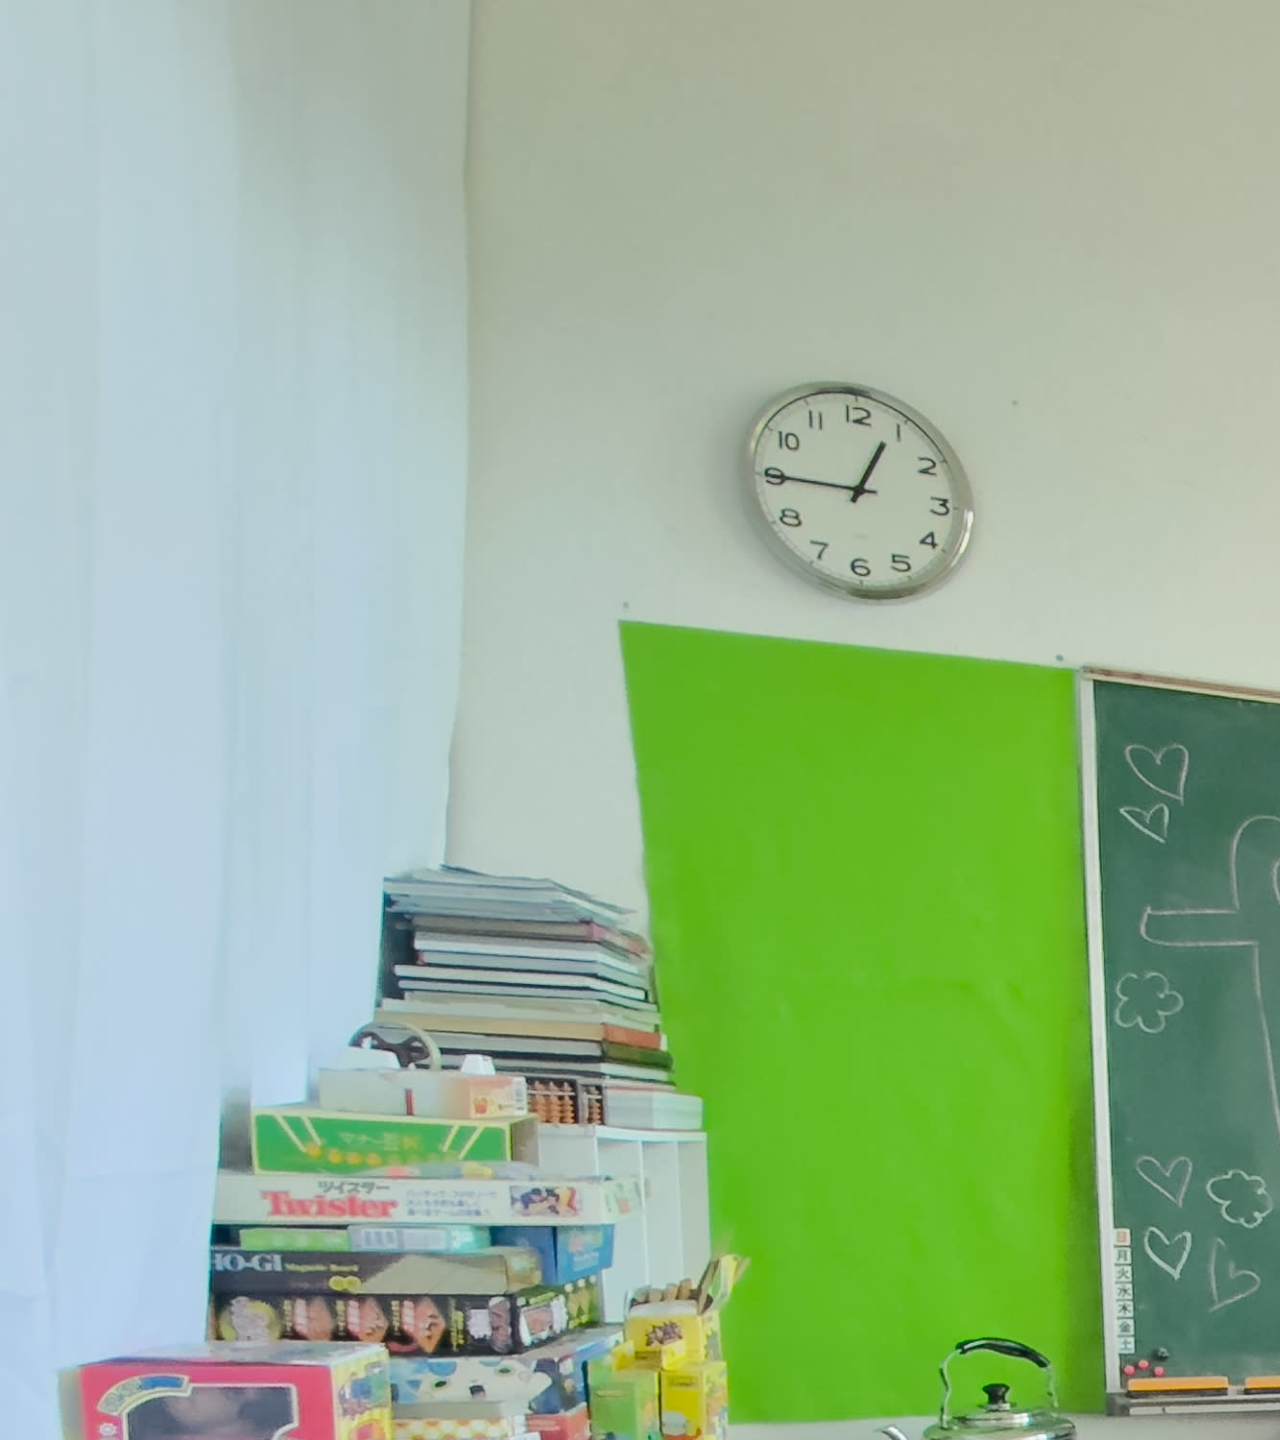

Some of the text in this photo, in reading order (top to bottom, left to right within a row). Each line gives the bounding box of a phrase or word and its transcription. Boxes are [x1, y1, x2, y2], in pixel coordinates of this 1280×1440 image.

[808, 410, 823, 430] 11
[845, 404, 872, 427] 12
[778, 430, 800, 451] 10
[896, 424, 902, 442] 1
[764, 467, 785, 486] 9
[917, 457, 937, 476] 2
[929, 496, 951, 517] 3
[779, 508, 803, 528] 8
[918, 531, 938, 549] 4
[810, 540, 829, 561] 7
[850, 558, 872, 578] 6
[891, 554, 912, 573] 5
[317, 1180, 390, 1194] ツイスター
[260, 1190, 400, 1218] Twister
